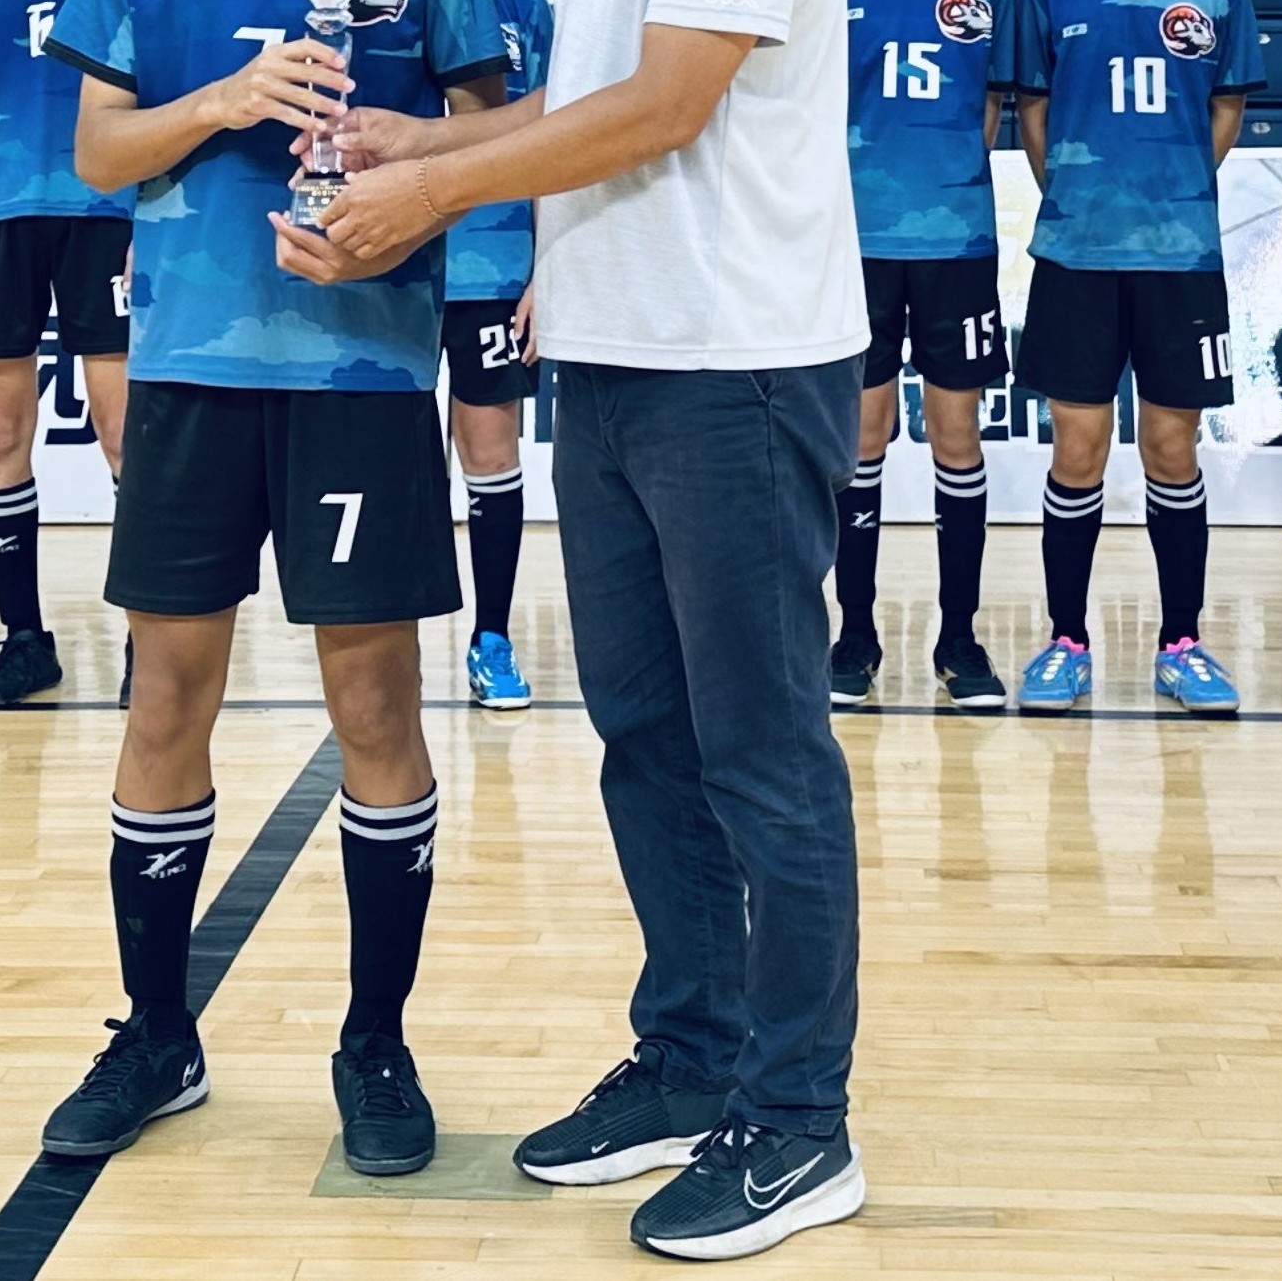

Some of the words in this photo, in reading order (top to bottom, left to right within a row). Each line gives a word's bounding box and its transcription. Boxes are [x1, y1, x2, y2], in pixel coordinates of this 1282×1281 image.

[882, 41, 942, 100] 15
[1108, 56, 1166, 114] 10
[962, 309, 996, 360] 15
[1198, 332, 1232, 380] 10
[319, 492, 364, 563] 7
